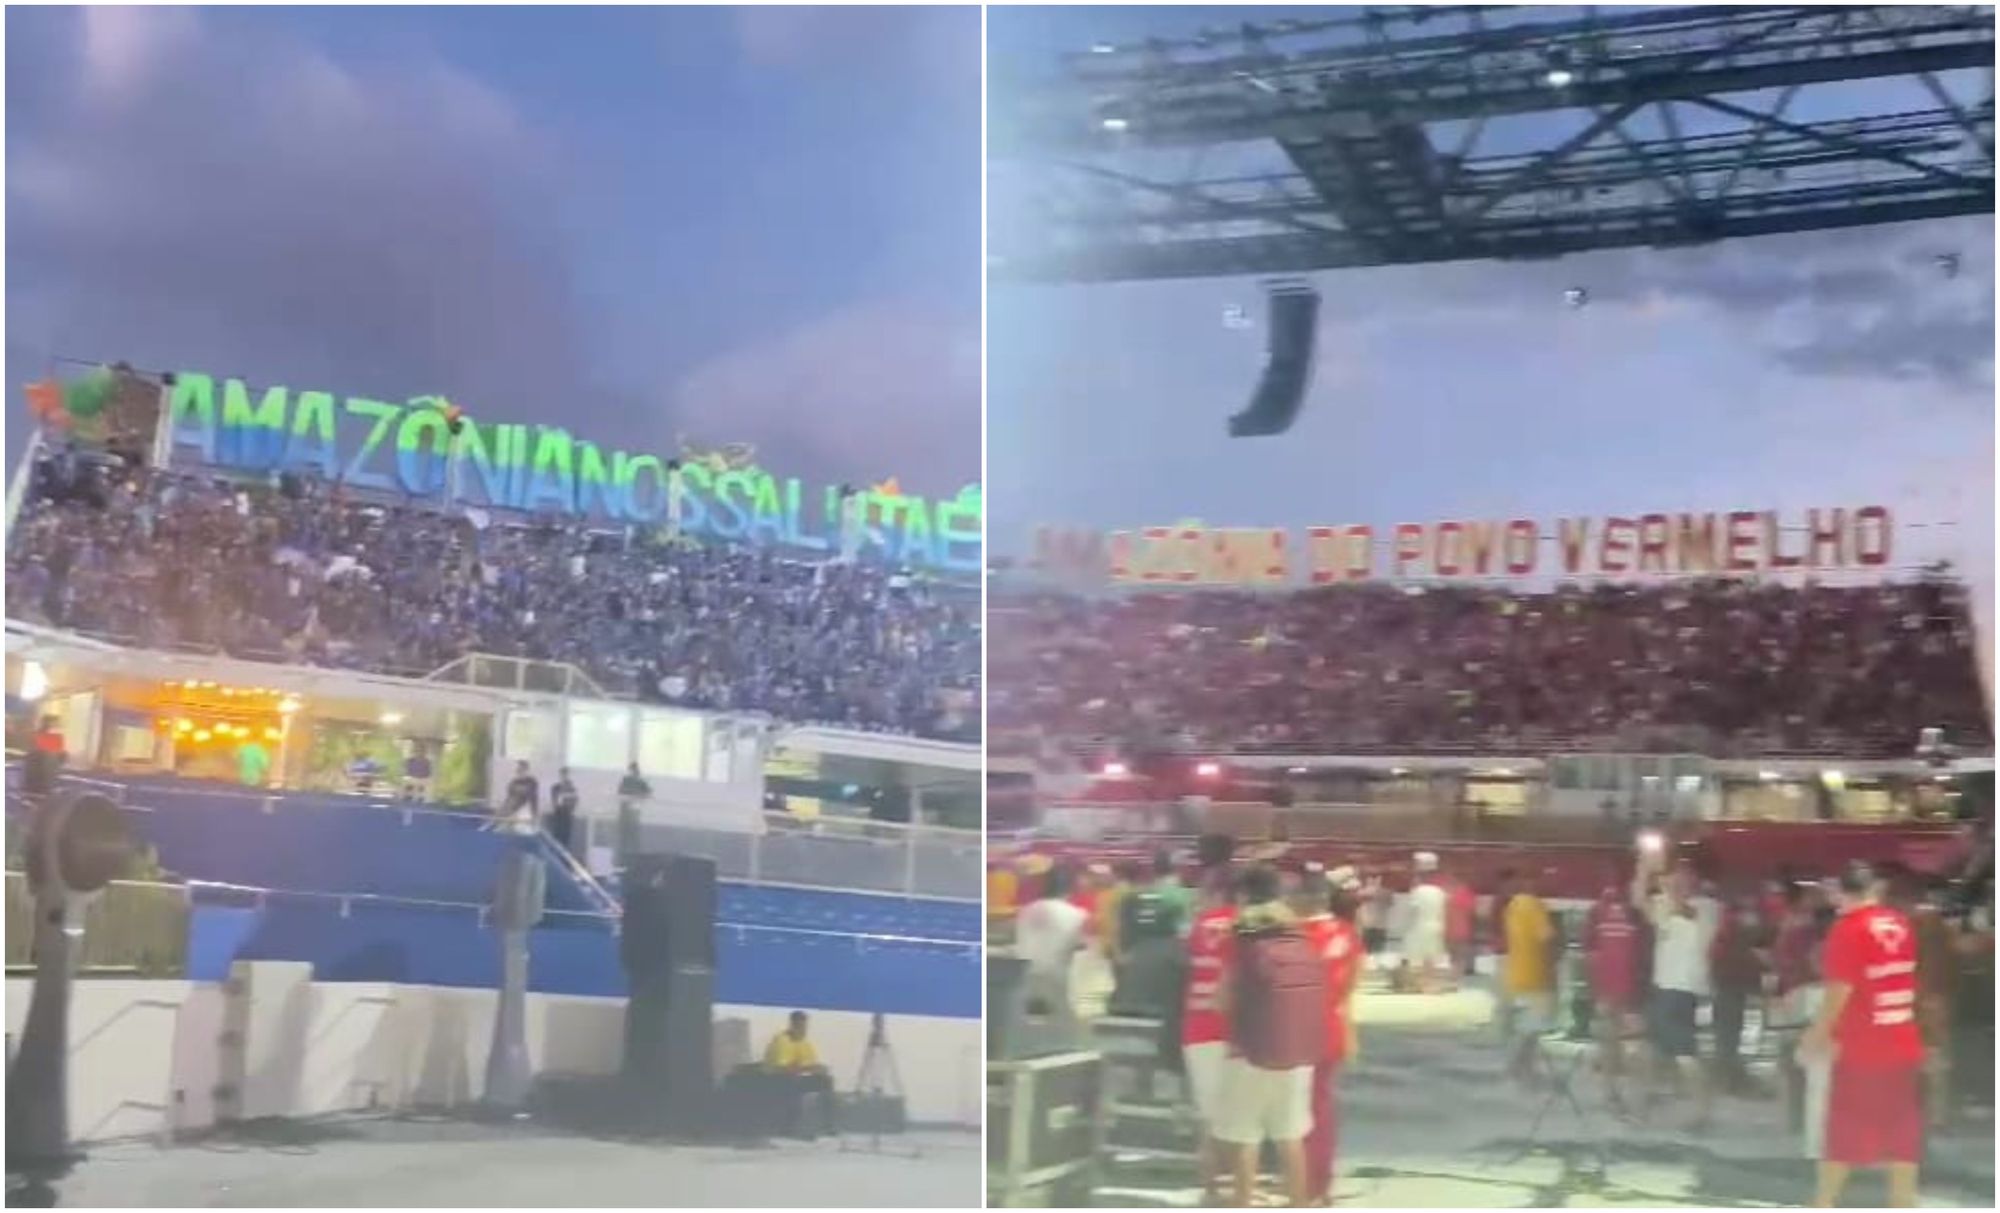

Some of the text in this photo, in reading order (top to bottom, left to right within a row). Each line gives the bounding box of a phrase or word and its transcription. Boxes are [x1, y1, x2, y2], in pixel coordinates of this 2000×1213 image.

[170, 371, 577, 514] AMAZÔNIA
[568, 438, 783, 545] NOSSA
[1308, 525, 1374, 583] DO
[1395, 520, 1541, 577] POVO
[1557, 504, 1893, 572] VERMELHO
